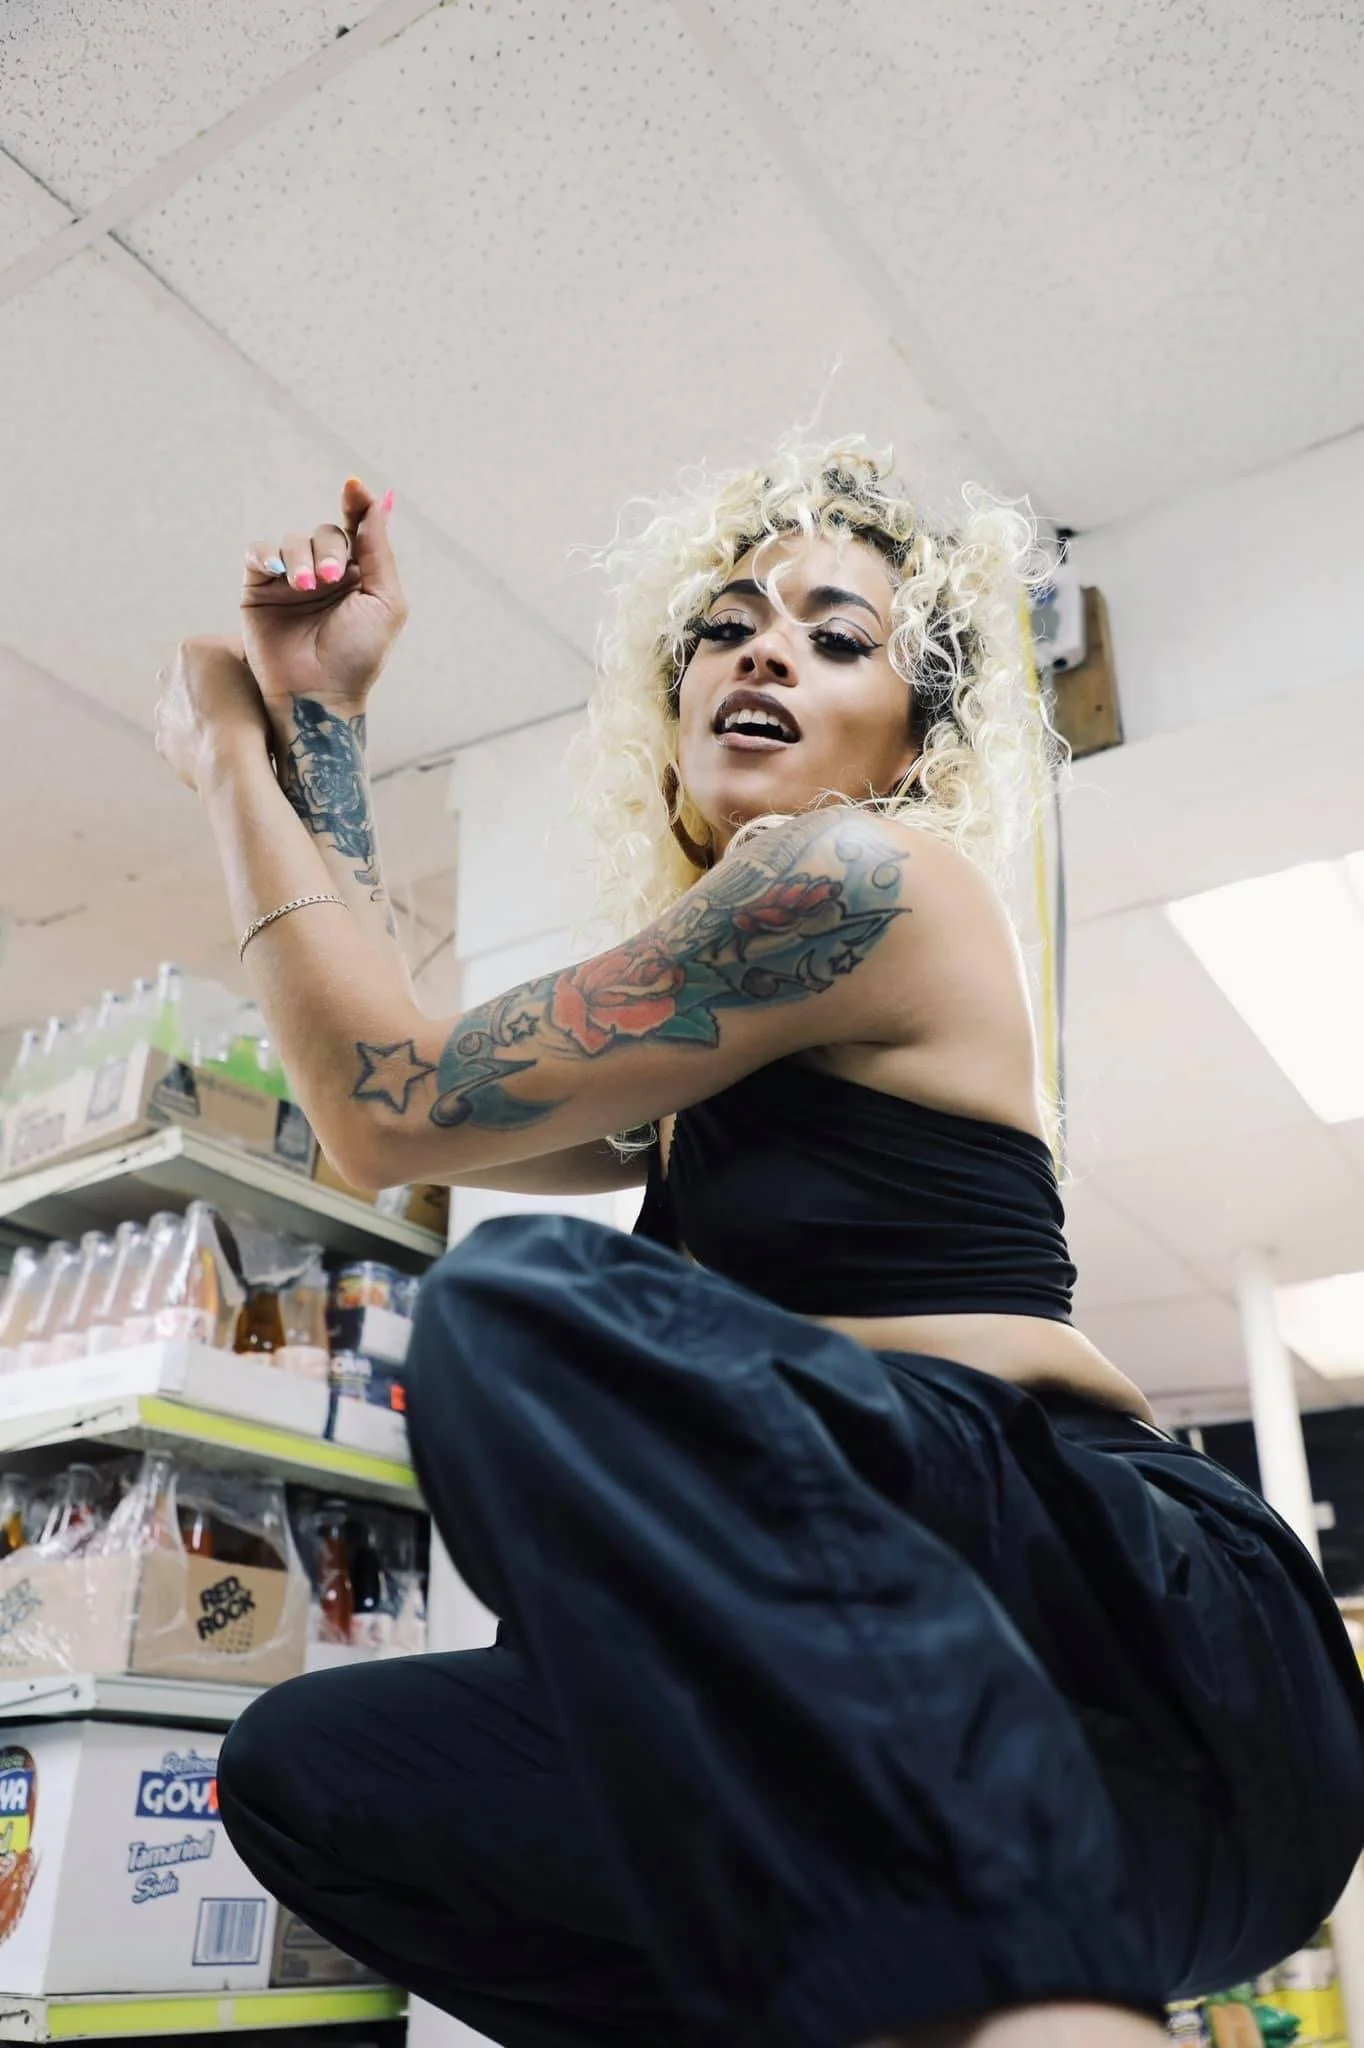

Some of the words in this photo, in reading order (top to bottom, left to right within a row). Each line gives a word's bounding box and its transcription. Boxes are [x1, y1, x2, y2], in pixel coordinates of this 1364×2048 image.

[197, 1589, 256, 1640] ROCK
[200, 1575, 240, 1613] RED
[127, 1829, 215, 1873] Tamarind
[131, 1870, 179, 1904] Soda
